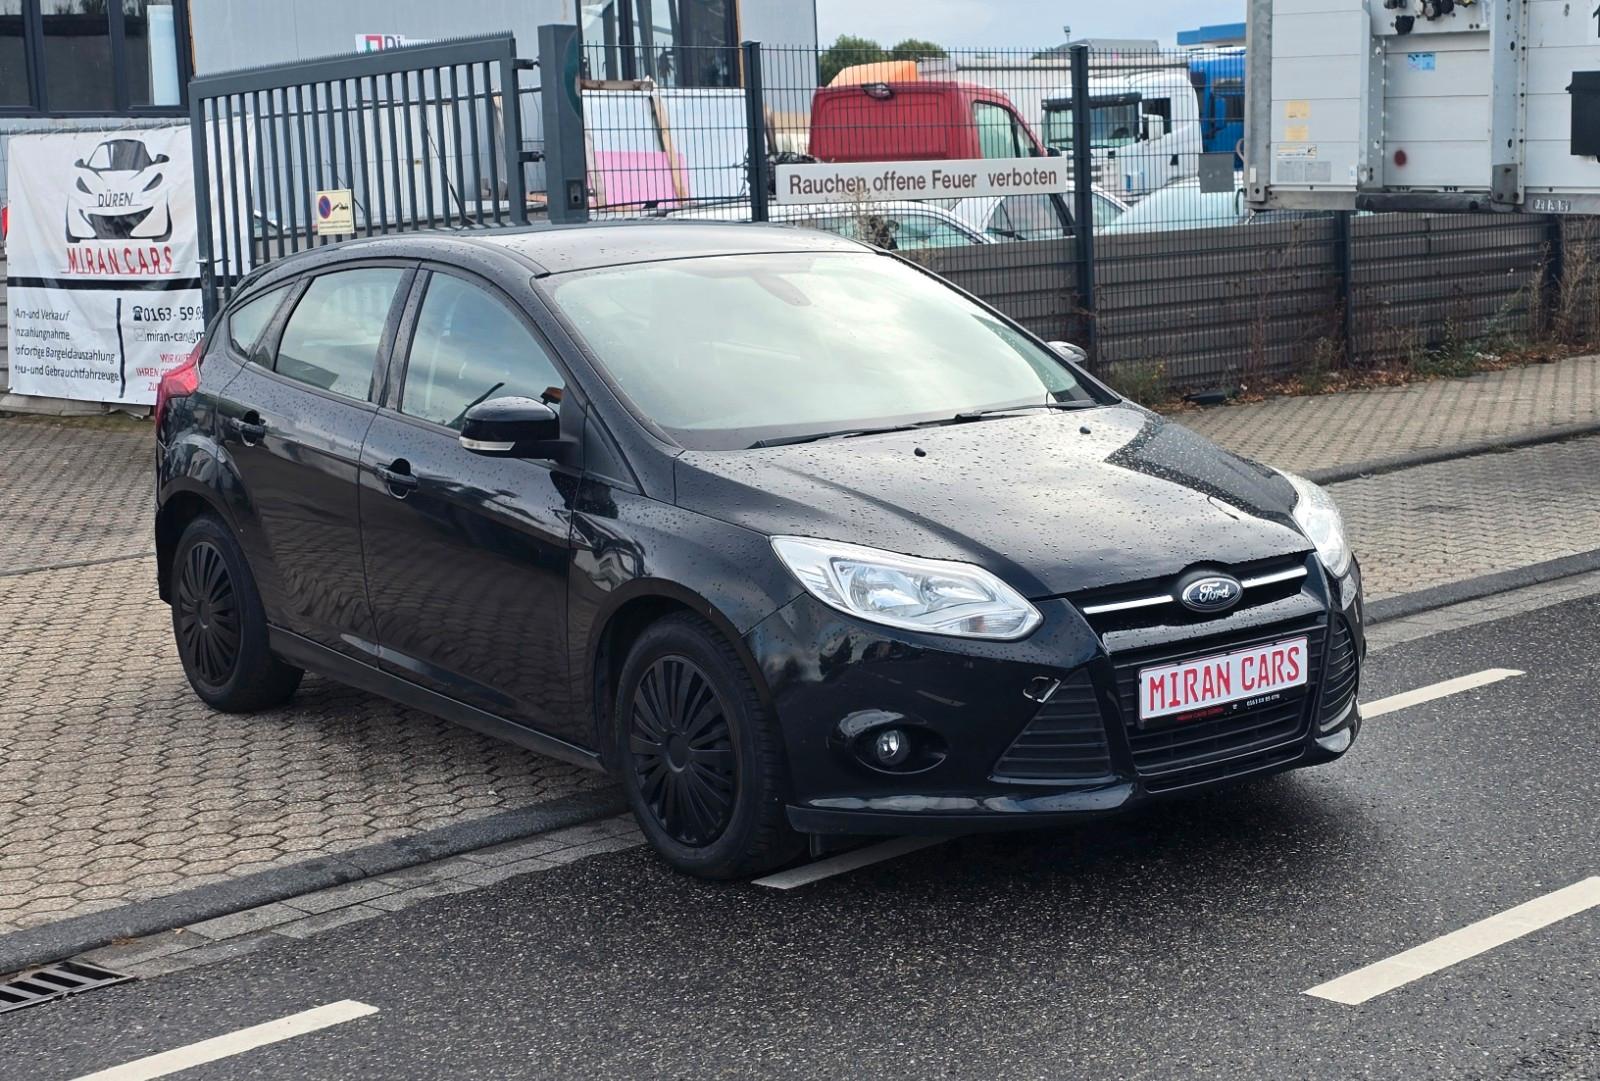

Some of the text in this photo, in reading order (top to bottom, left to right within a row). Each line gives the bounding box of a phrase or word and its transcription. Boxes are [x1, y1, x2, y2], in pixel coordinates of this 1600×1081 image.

[790, 167, 1057, 195] Rauchen, offene Feuer verboten
[98, 189, 134, 207] DÜREN
[67, 246, 172, 274] MIRAN CARS
[144, 307, 172, 322] 0163
[15, 326, 70, 341] nzahlungnahme
[45, 346, 115, 365] Bargeldauszahlung
[15, 364, 119, 384] eu-und Gebrauchtfahrzeuge
[1199, 582, 1231, 603] Ford
[1150, 646, 1300, 712] MIRAN CARS
